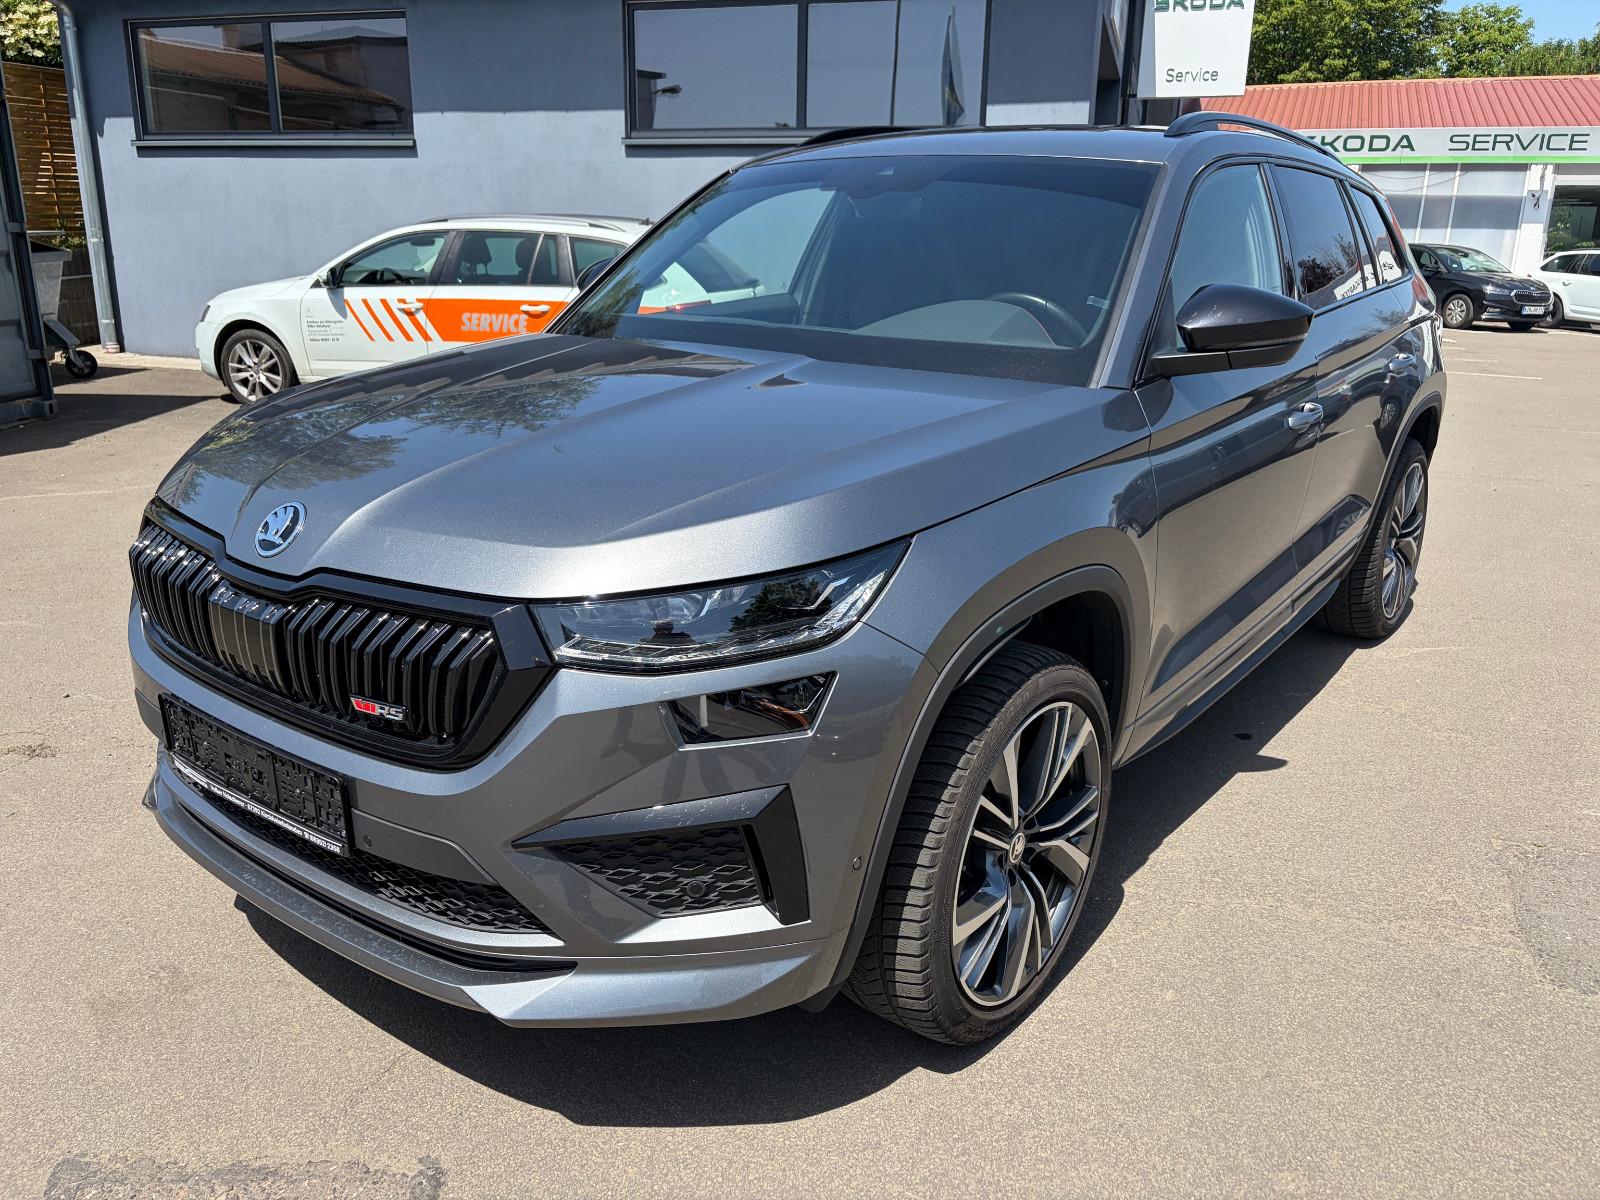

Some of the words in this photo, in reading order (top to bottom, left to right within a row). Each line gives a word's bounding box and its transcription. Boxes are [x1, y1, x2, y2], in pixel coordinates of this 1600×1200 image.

[1165, 68, 1219, 83] Service
[1306, 134, 1416, 152] KODA
[1448, 133, 1591, 151] SERVICE
[461, 312, 528, 334] SERVICE
